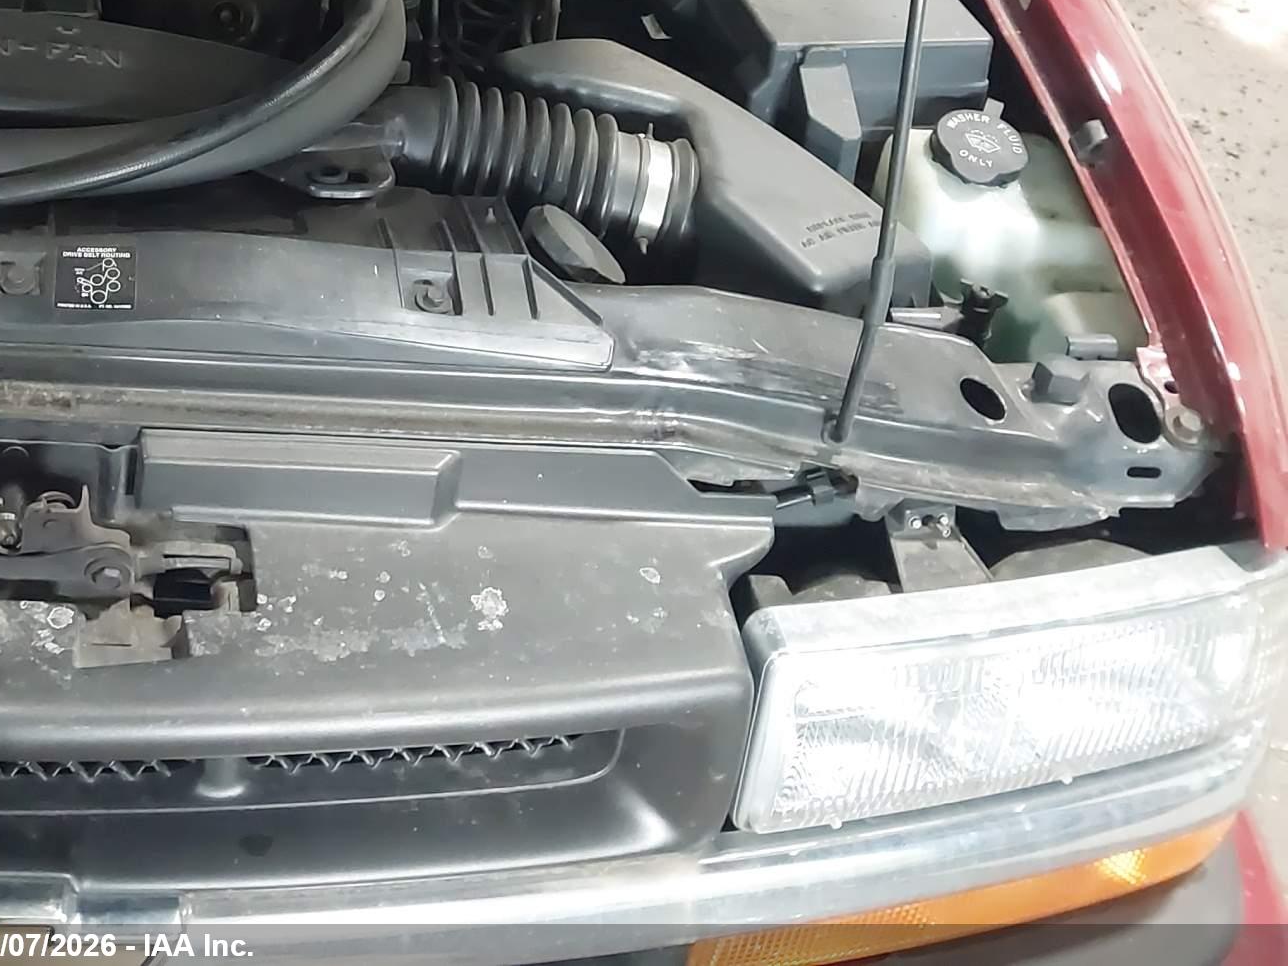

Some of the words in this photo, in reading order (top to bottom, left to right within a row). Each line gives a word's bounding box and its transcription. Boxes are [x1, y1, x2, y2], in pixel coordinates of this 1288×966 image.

[946, 113, 991, 129] WASHER
[995, 123, 1023, 154] FLUID
[958, 150, 993, 168] ONLY
